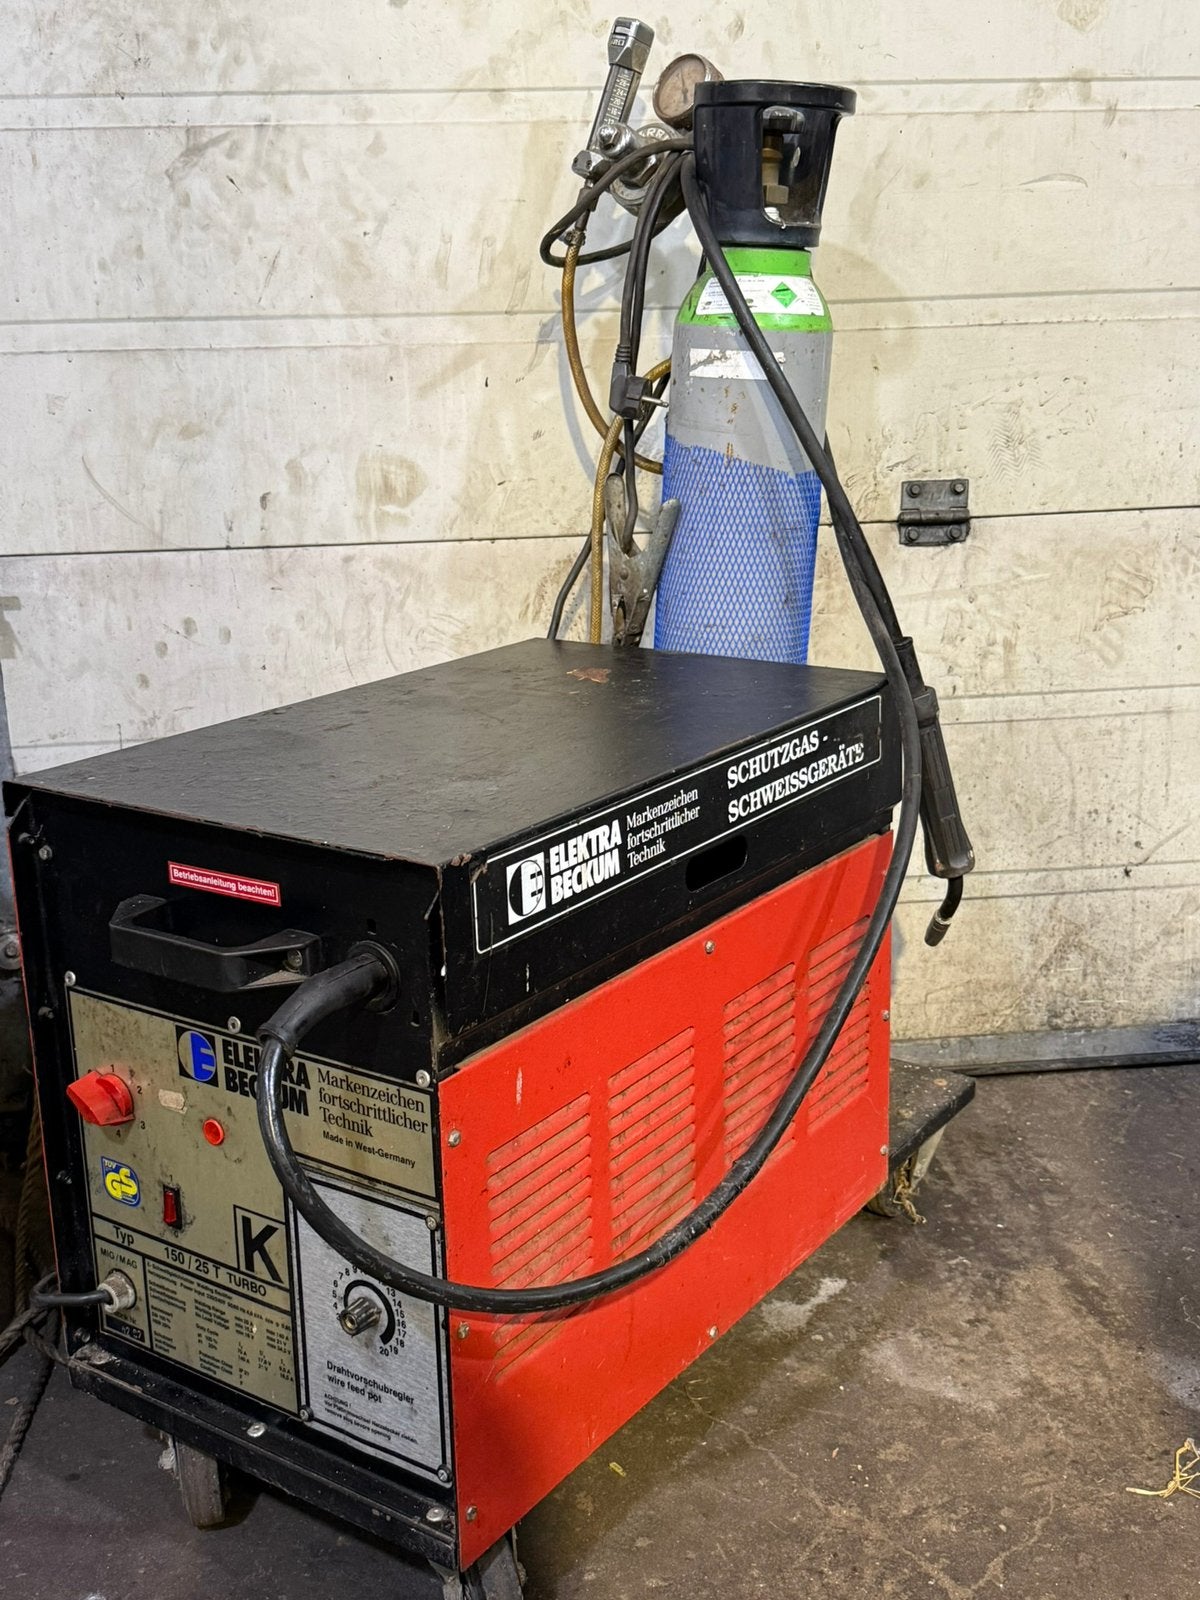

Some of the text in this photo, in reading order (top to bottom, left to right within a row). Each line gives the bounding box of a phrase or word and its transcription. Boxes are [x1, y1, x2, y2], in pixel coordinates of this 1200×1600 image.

[727, 730, 820, 789] SCHUTZGAS
[728, 742, 864, 824] SCHWEISSGERÄTE
[626, 788, 698, 831] Markenzeichen
[627, 806, 700, 850] fortschrittlicher
[550, 819, 622, 876] ELEKTRA
[627, 838, 667, 868] Technik
[173, 868, 275, 897] Betriebsanleitung beachten!
[550, 848, 620, 904] BECKUM
[222, 1038, 311, 1090] ELERA
[318, 1068, 425, 1113] Markenzeichen
[318, 1087, 428, 1134] fortschrittlicher
[320, 1106, 374, 1138] Technik
[323, 1130, 416, 1168] Made in West-Germany
[114, 1225, 134, 1246] Typ
[164, 1246, 185, 1265] 150
[195, 1260, 209, 1276] 25
[214, 1266, 221, 1279] T
[226, 1272, 267, 1297] TURBO
[242, 1215, 284, 1284] K
[386, 1287, 396, 1297] 13
[393, 1299, 402, 1308] 14
[396, 1309, 405, 1318] 15
[397, 1320, 406, 1329] 16
[380, 1346, 389, 1356] 20
[390, 1344, 398, 1354] 19
[395, 1338, 405, 1348] 18
[398, 1329, 406, 1338] 17
[327, 1360, 414, 1404] Drahtvorschubregler
[328, 1375, 382, 1404] wire feed pot
